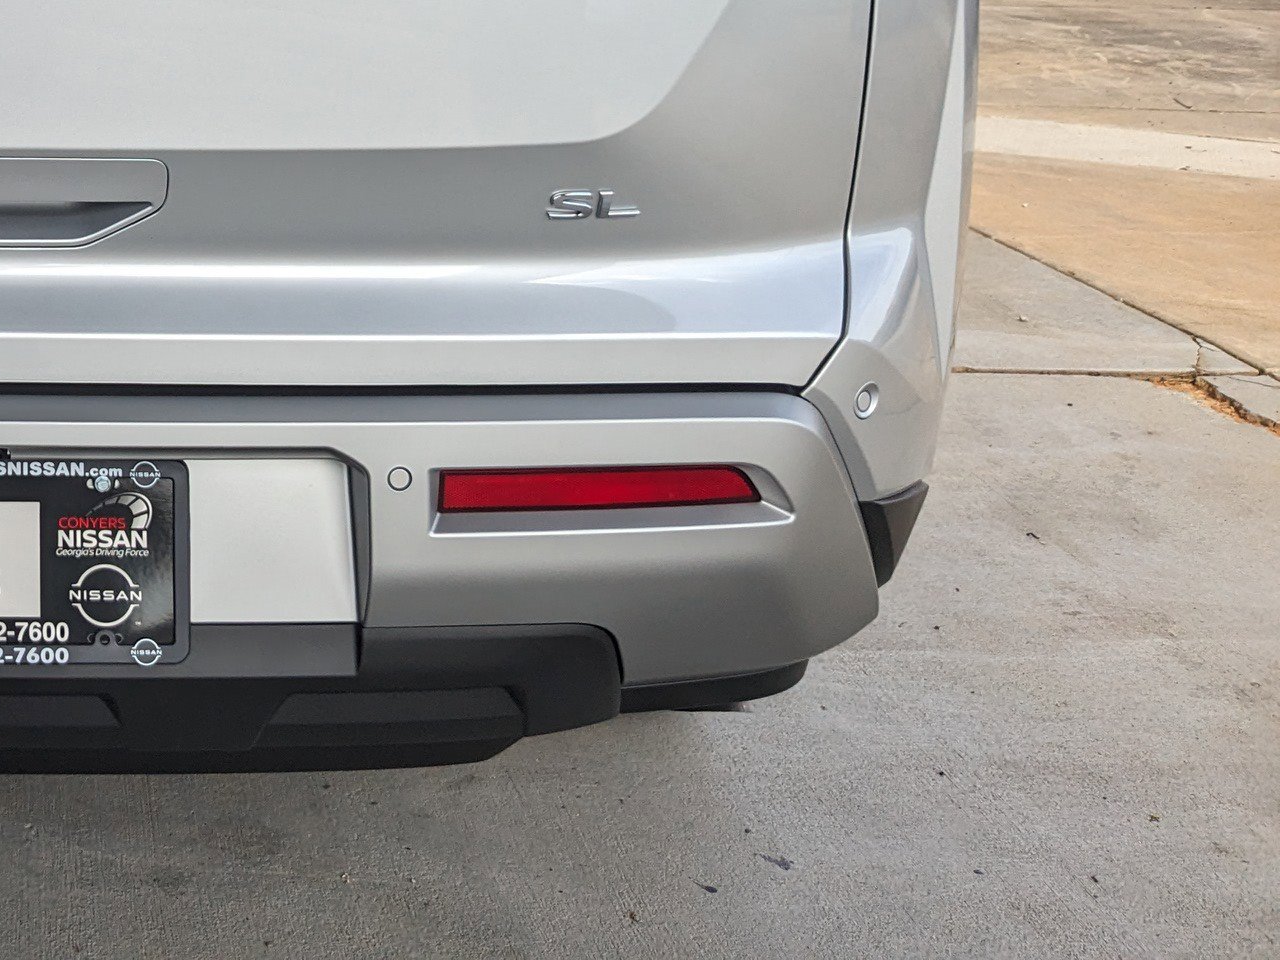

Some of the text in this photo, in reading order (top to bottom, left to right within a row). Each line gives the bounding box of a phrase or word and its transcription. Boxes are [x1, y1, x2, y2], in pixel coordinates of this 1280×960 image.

[546, 188, 641, 219] SL
[58, 516, 127, 529] CONYERS
[57, 529, 148, 548] NISSAN
[55, 547, 150, 558] Georgia's Driving Force
[69, 589, 142, 602] NISSAN
